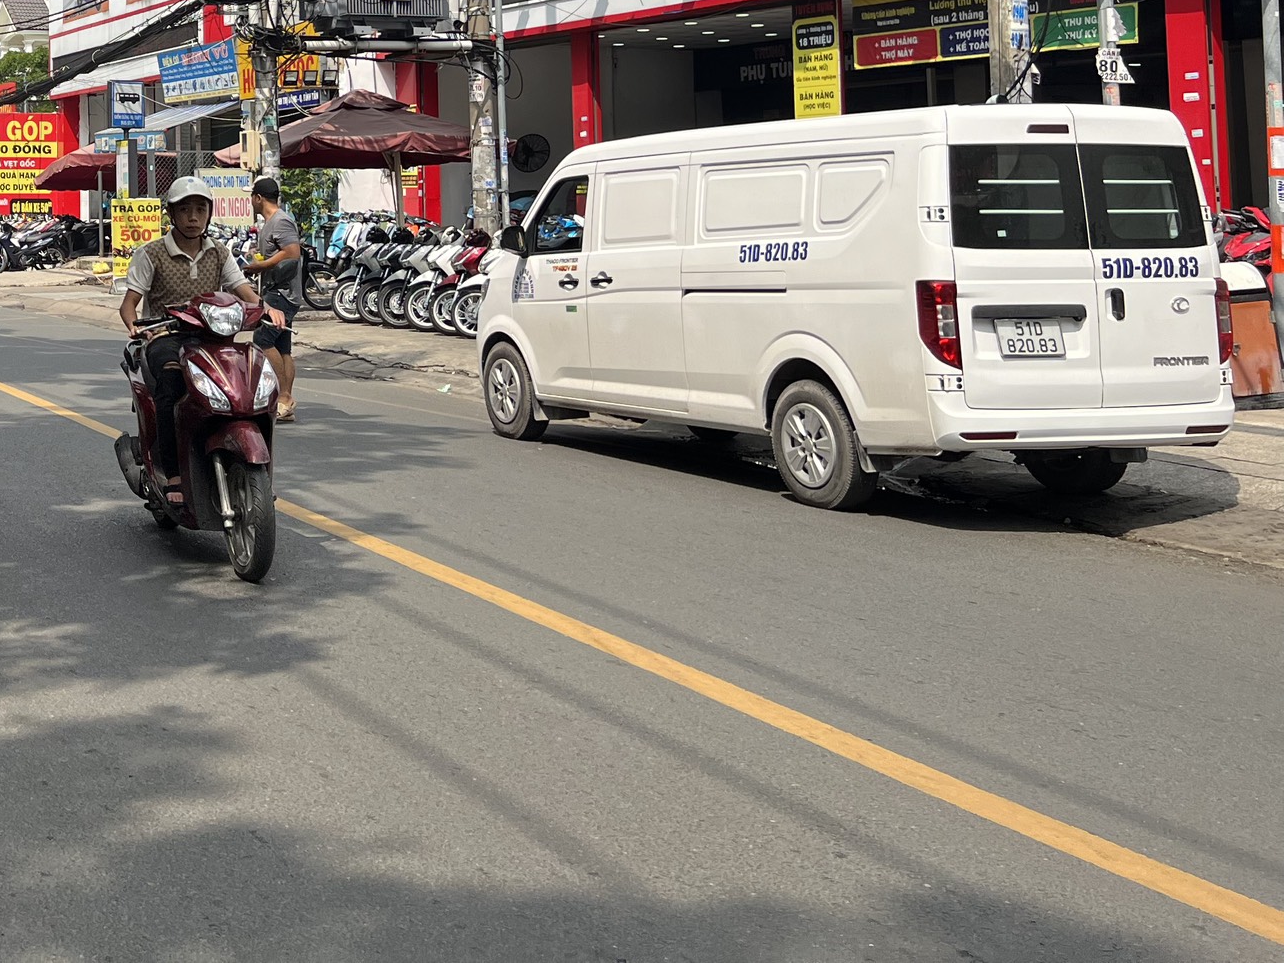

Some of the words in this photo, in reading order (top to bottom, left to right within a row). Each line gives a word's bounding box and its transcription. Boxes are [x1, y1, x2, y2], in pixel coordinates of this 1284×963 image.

[930, 14, 950, 27] (sau
[951, 12, 958, 22] 2
[958, 9, 984, 23] tháng
[1064, 16, 1084, 27] THU
[798, 37, 808, 47] 18
[809, 33, 832, 47] TRIỆU
[955, 28, 972, 41] THỢ
[1084, 27, 1097, 39] KÝ
[955, 40, 967, 53] KẾ
[881, 50, 896, 61] THỢ
[897, 47, 914, 58] MÁY
[1098, 59, 1118, 74] 80
[739, 63, 766, 85] PHỤ
[6, 115, 53, 141] GÓP
[12, 141, 52, 155] ĐỒNG
[12, 182, 35, 193] DUYỆ
[138, 202, 160, 213] GÓP
[120, 229, 152, 242] 500
[739, 241, 809, 264] 51D-820.83
[1101, 256, 1200, 280] 51D-820.83
[1015, 320, 1044, 337] 51D
[1006, 337, 1058, 354] 820.83
[1153, 355, 1210, 368] FRONTIER
